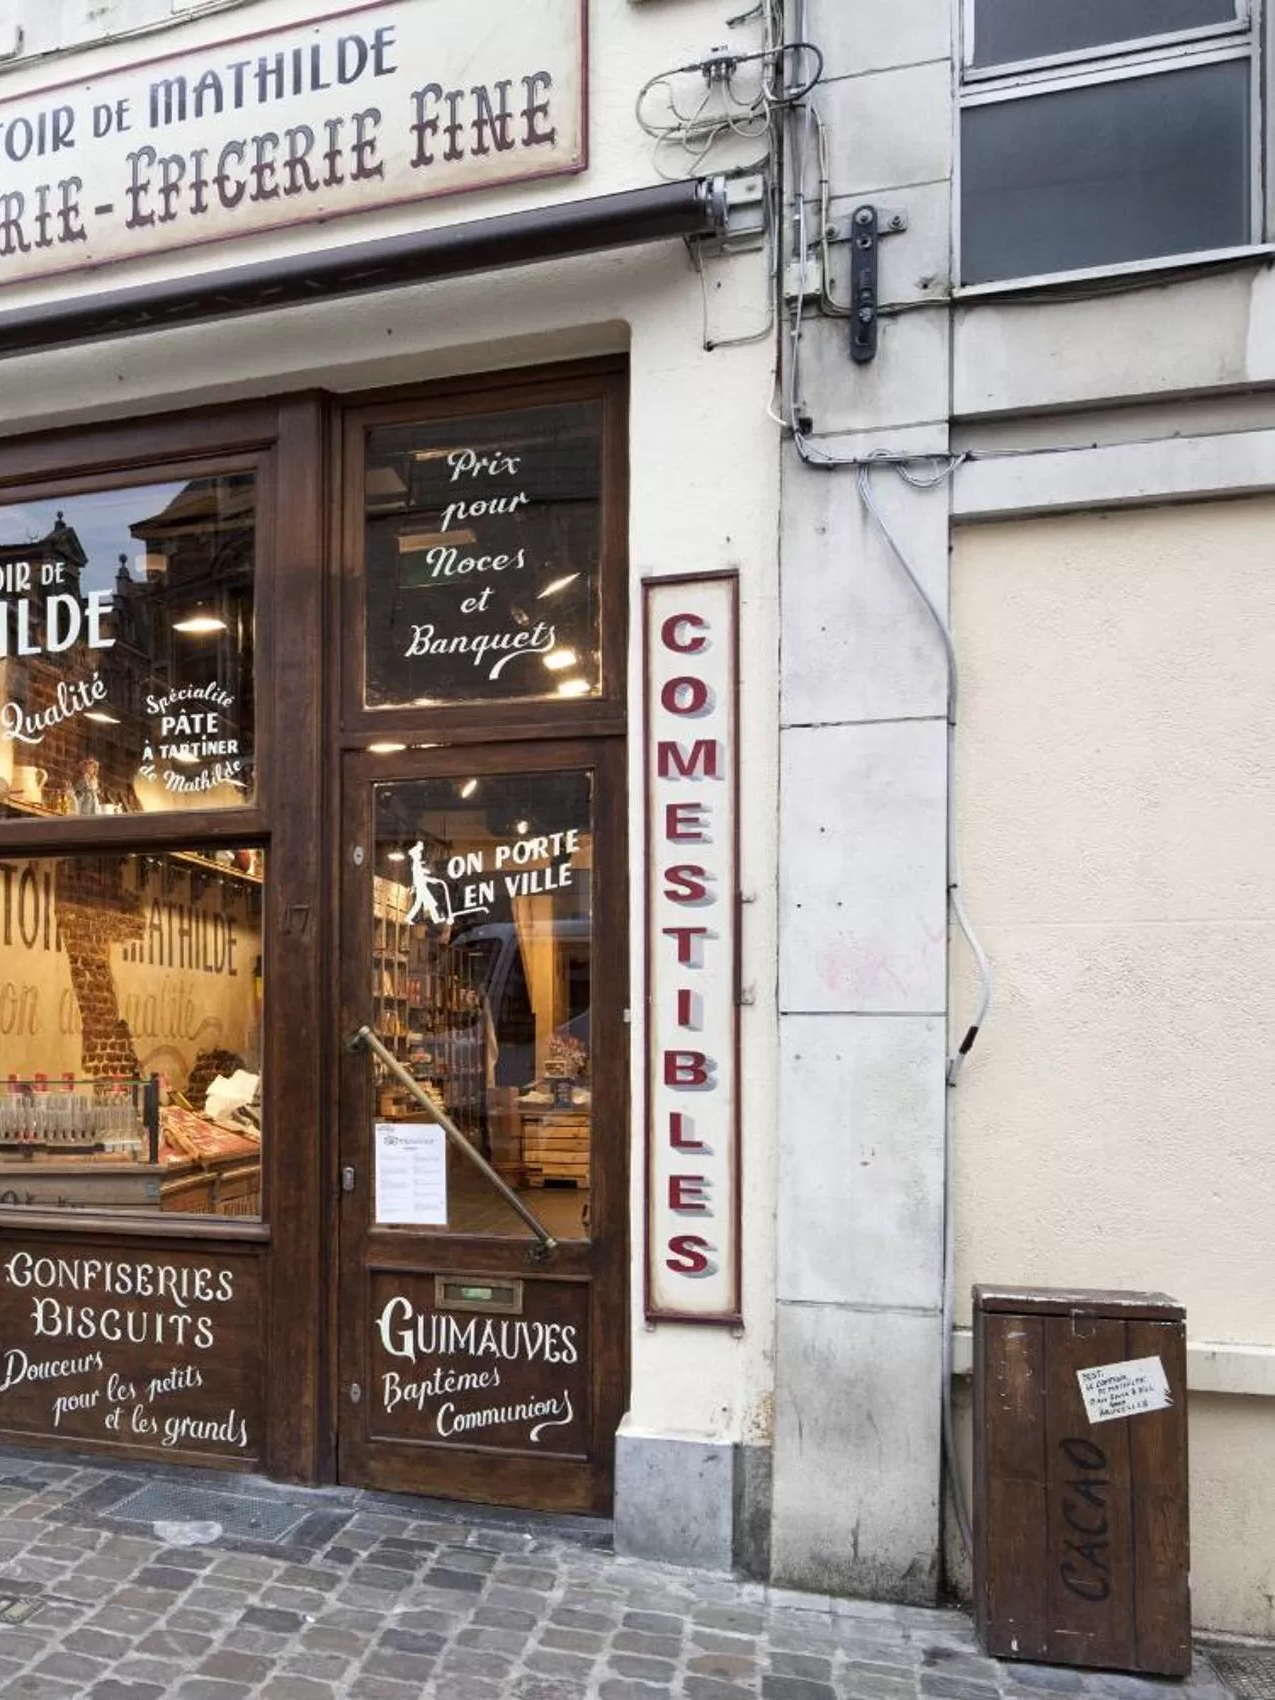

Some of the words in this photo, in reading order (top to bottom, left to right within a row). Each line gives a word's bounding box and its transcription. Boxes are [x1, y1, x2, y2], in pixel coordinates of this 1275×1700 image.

[93, 99, 131, 138] DE
[149, 25, 398, 129] MATHILDE
[410, 70, 558, 171] FINE
[446, 448, 522, 483] Prix
[441, 491, 530, 532] pour
[41, 562, 65, 585] DE
[426, 546, 525, 578] Noces
[460, 586, 494, 613] et
[404, 621, 556, 681] Banquets
[0, 671, 108, 745] Qualité
[146, 681, 235, 714] Spécialité
[161, 708, 219, 736] PÂTE
[139, 764, 157, 783] de
[163, 761, 242, 792] Mathilde
[447, 851, 483, 879] ON
[495, 829, 580, 869] PORTE
[464, 880, 495, 908] EN
[504, 863, 573, 898] VILLE
[122, 896, 238, 976] ATHILDE
[657, 612, 723, 1279] COMESTIBLES
[4, 1252, 234, 1308] CONFISERIES
[30, 1296, 214, 1349] BISCUITS
[375, 1296, 577, 1364] GUIMAUVES
[0, 1349, 104, 1392] Douceurs
[381, 1367, 500, 1413] Baptêmes
[52, 1389, 100, 1427] pour
[107, 1373, 136, 1402] les
[147, 1365, 203, 1402] petits
[437, 1389, 573, 1442] Communions
[105, 1407, 124, 1429] et
[132, 1404, 158, 1433] les
[161, 1408, 247, 1447] grands
[1060, 1436, 1110, 1602] CACAO
